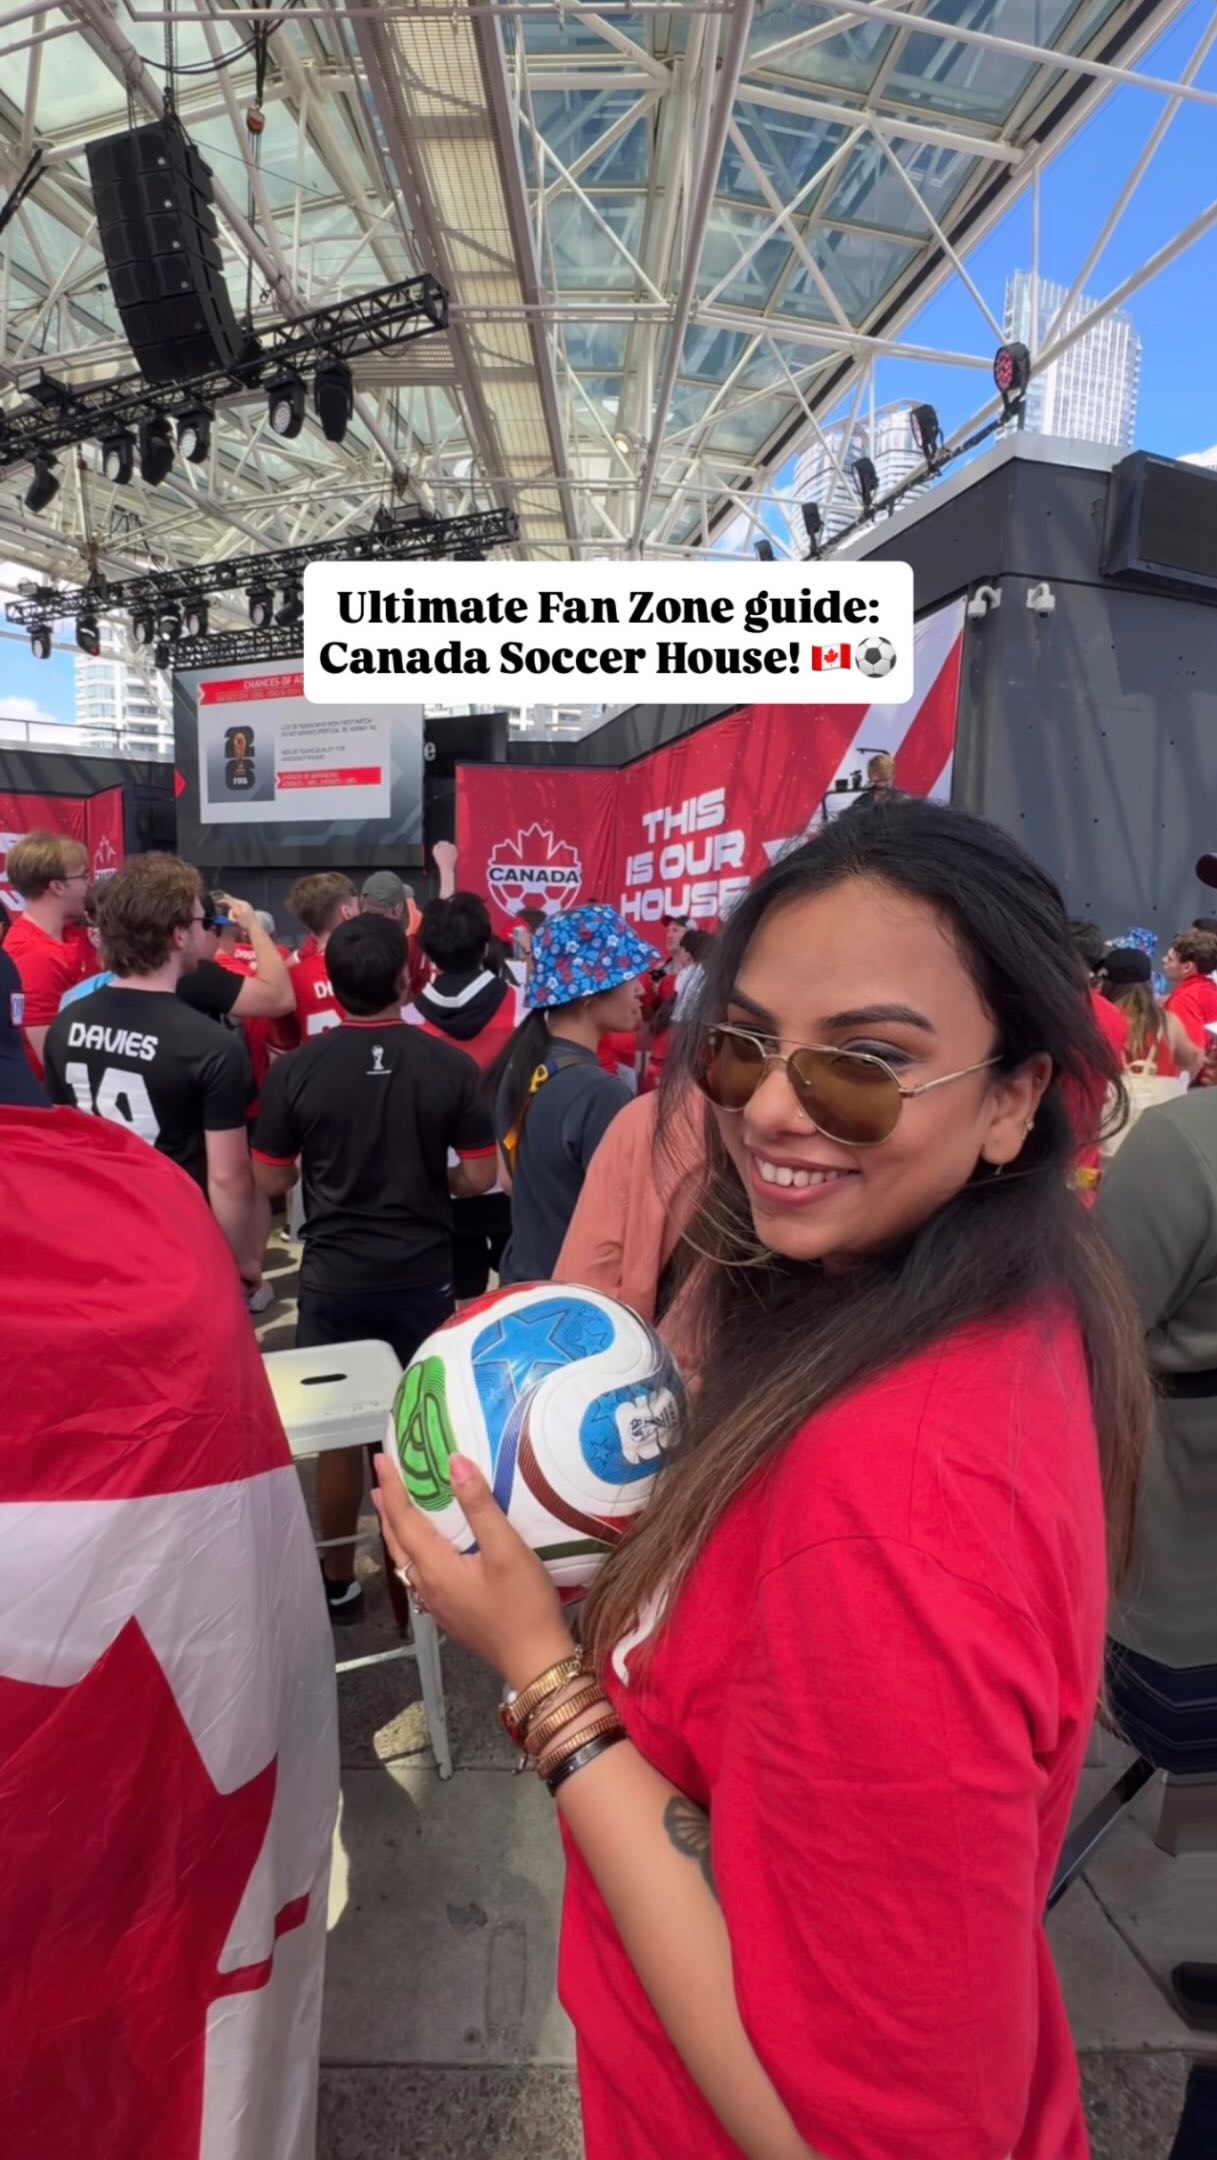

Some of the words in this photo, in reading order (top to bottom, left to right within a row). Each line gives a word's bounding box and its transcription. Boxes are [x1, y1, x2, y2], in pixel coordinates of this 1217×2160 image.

[232, 776, 249, 785] FIFA
[642, 786, 726, 844] THIS
[489, 867, 579, 884] CANADA
[625, 851, 654, 887] IS
[659, 829, 746, 881] OUR
[67, 1021, 159, 1062] DAVIES
